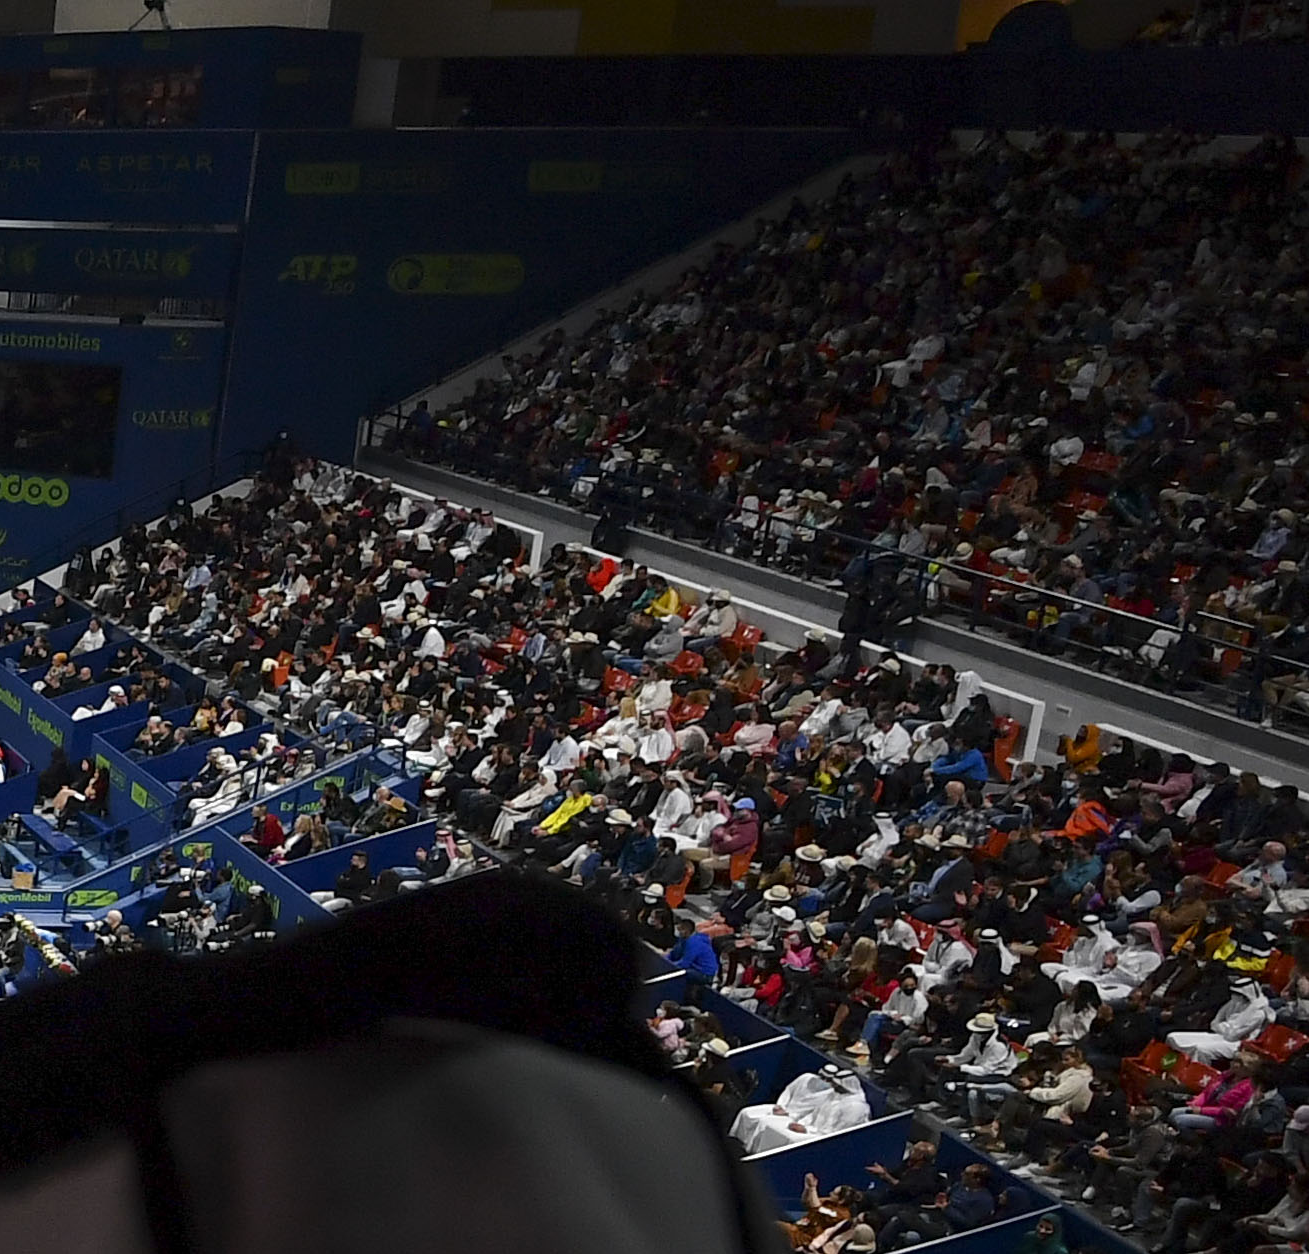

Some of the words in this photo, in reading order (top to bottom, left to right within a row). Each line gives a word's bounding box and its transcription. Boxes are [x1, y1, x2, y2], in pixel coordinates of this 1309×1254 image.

[76, 154, 213, 175] ASPETAR
[74, 247, 159, 273] QATAR
[277, 254, 358, 282] ATP
[133, 409, 190, 427] QATAR
